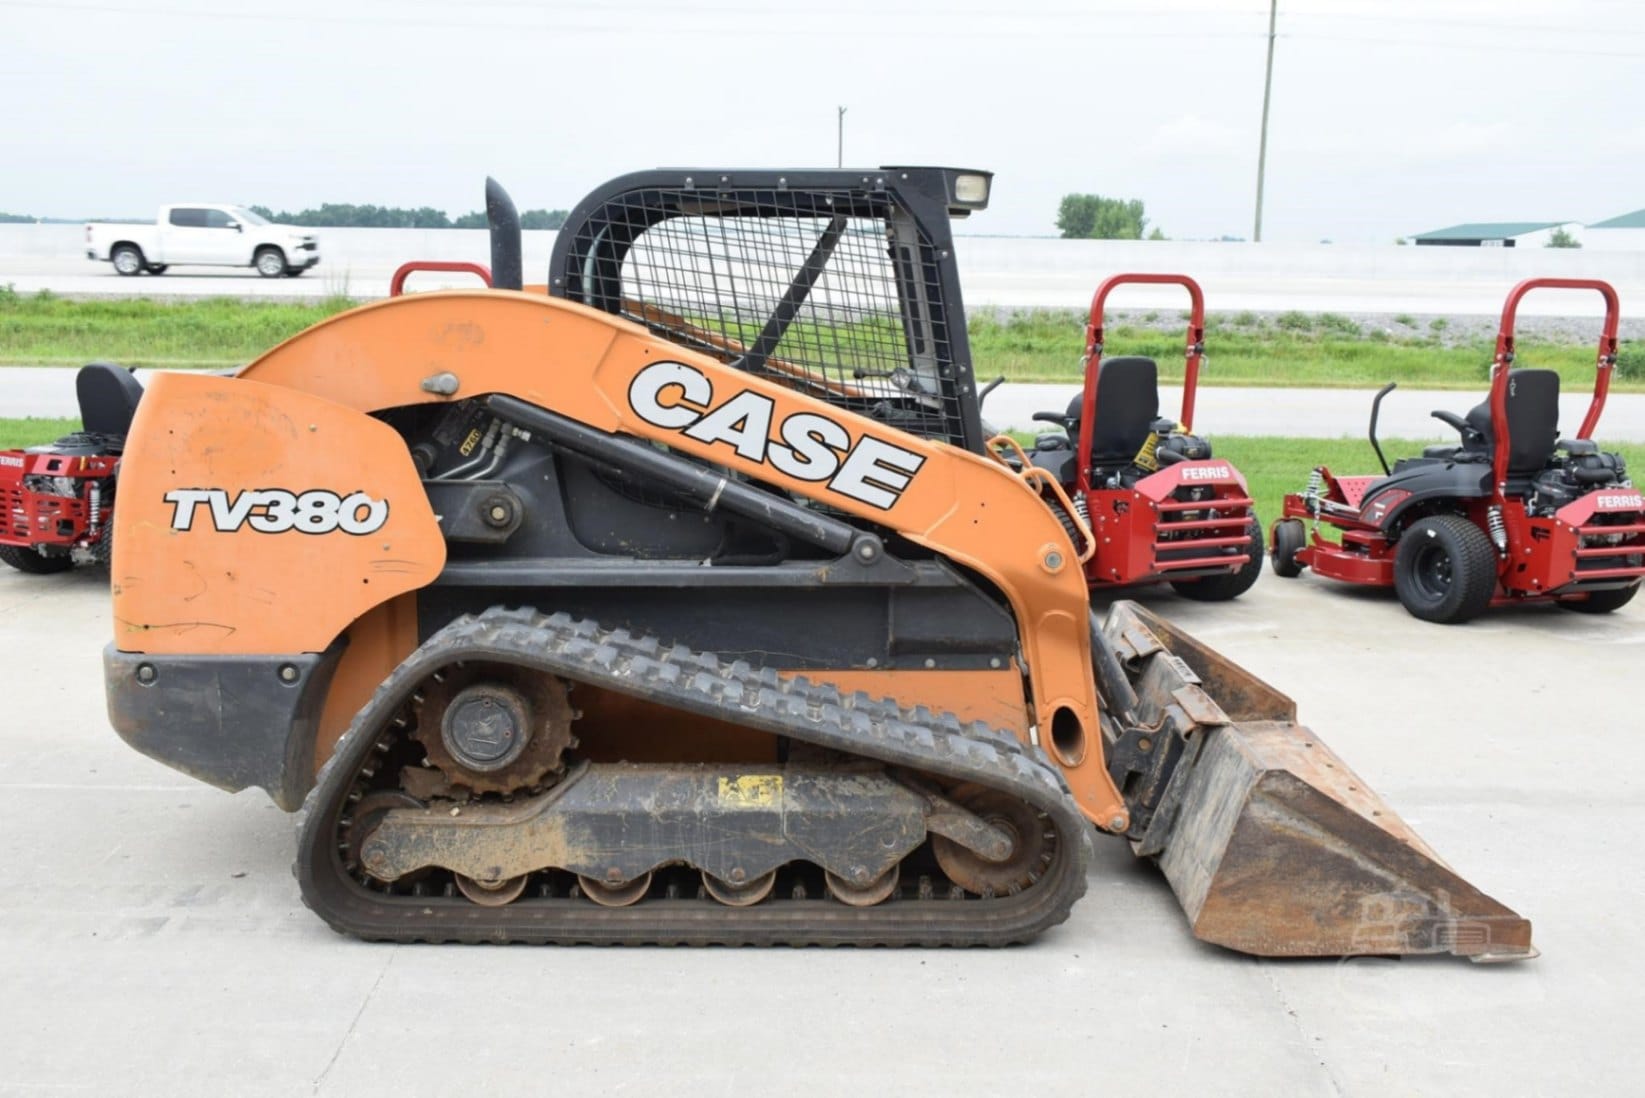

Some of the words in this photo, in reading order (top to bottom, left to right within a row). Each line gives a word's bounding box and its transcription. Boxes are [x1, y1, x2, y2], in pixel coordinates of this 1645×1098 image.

[628, 360, 927, 511] CASE
[0, 455, 24, 468] ERRIS
[1182, 466, 1230, 480] FERRIS
[1597, 495, 1643, 508] FERRIS
[163, 488, 390, 536] TV380
